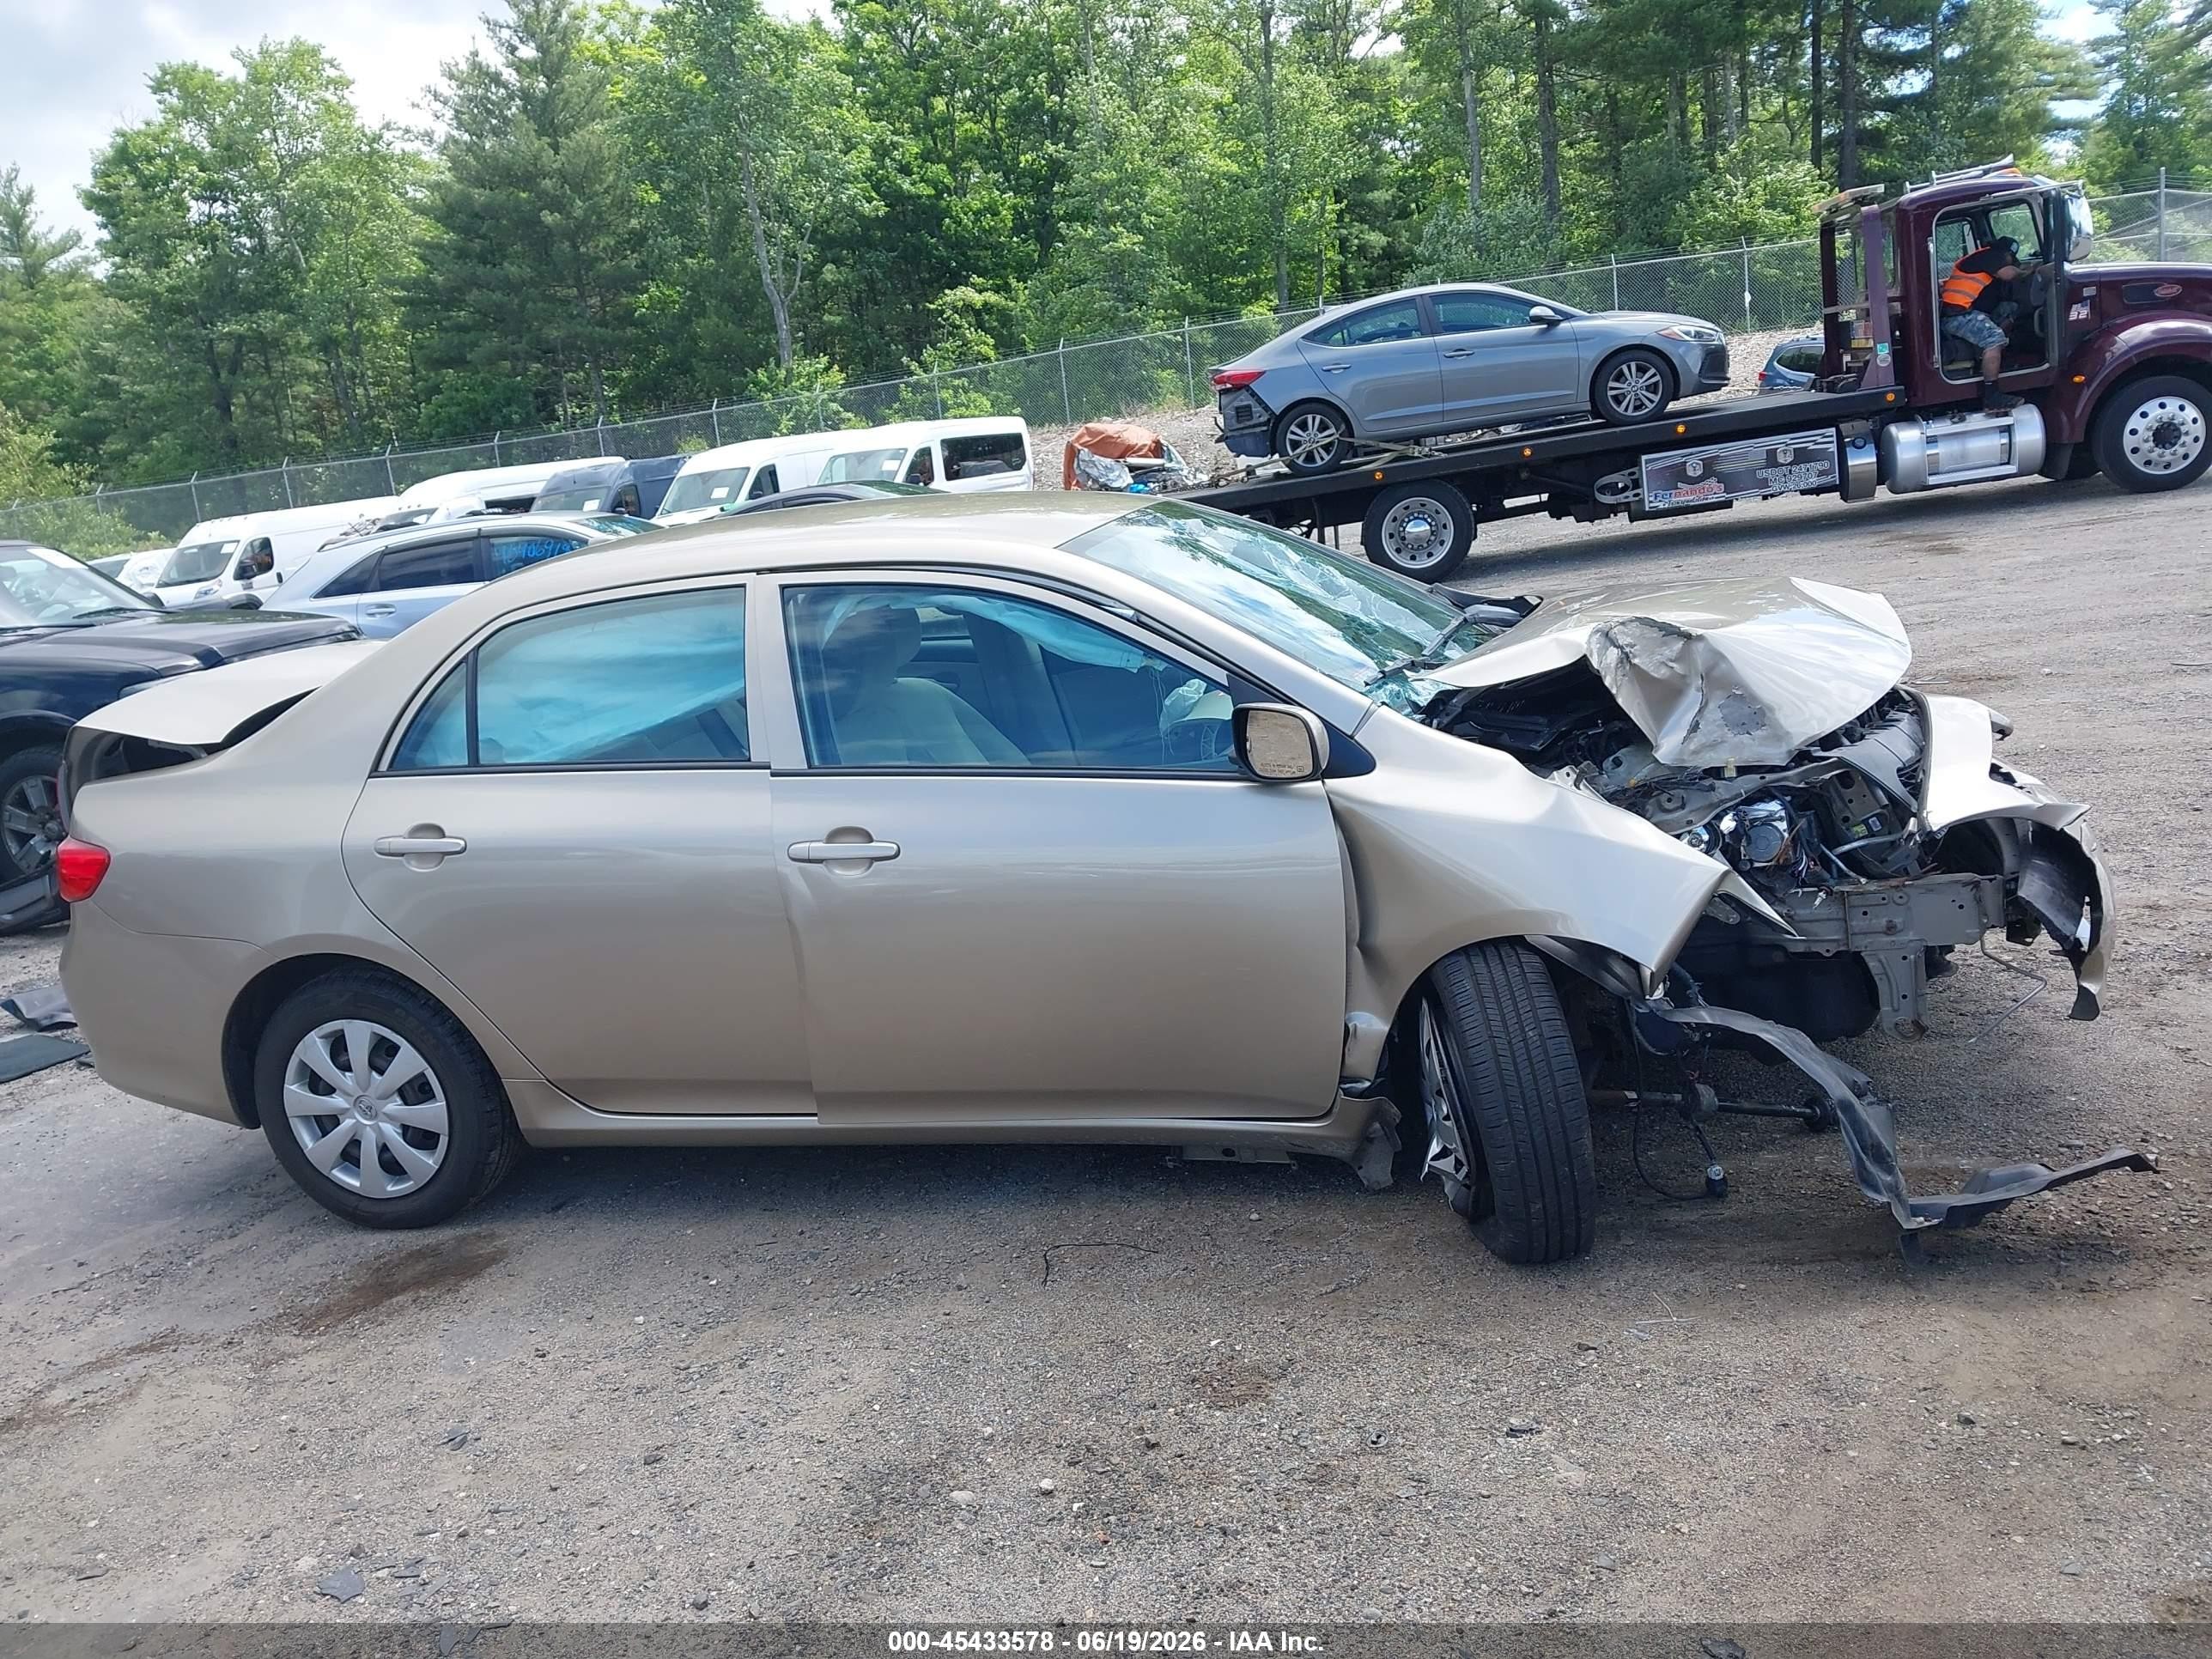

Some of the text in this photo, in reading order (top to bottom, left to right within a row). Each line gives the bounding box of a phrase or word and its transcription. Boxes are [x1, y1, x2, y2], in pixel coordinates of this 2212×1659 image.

[2069, 310, 2087, 321] 32
[1756, 460, 1830, 478] USDOT 2471790
[1768, 471, 1819, 486] MC 929707
[1653, 482, 1725, 502] Fernando's
